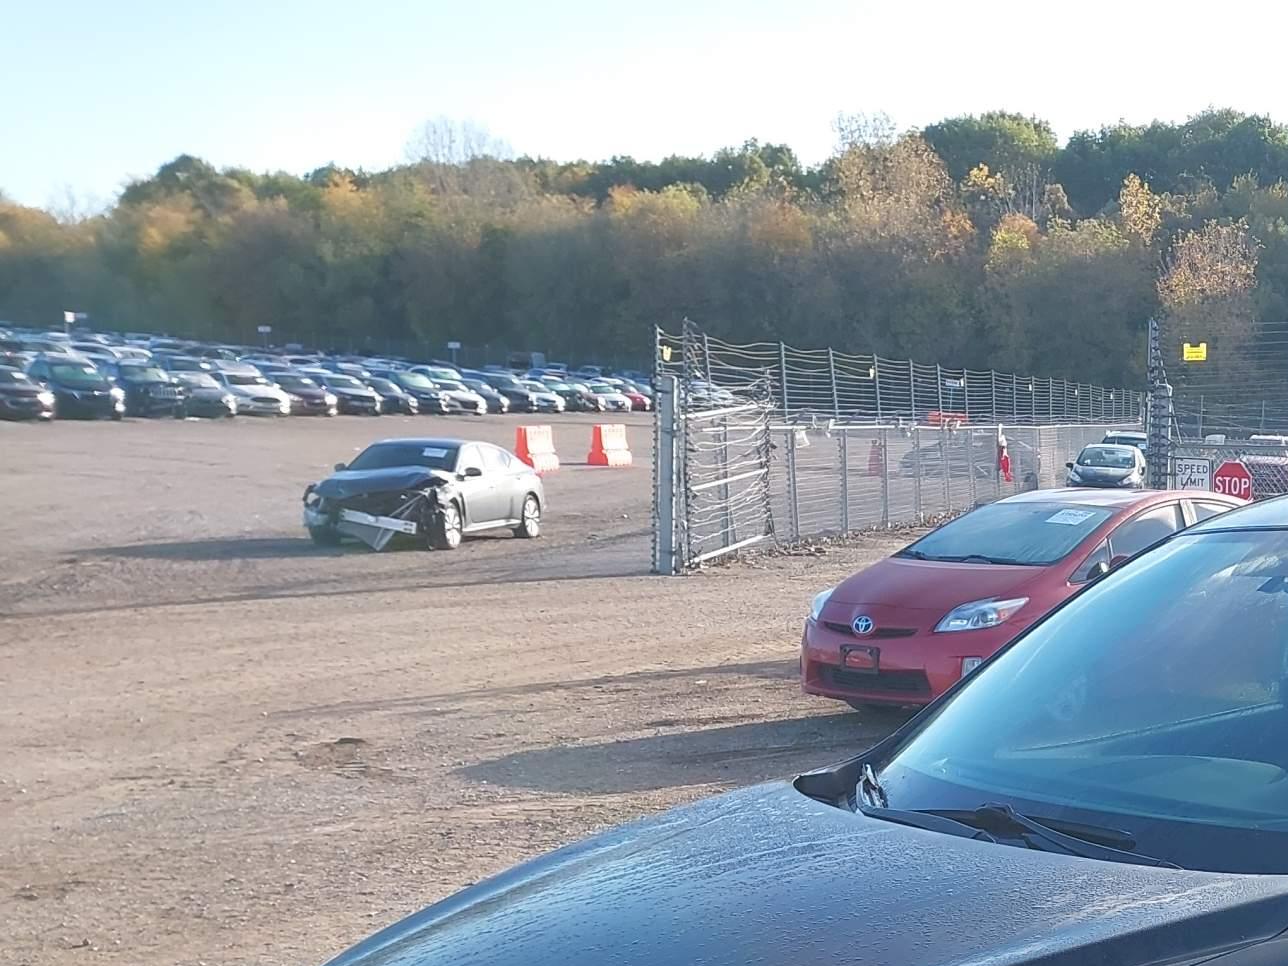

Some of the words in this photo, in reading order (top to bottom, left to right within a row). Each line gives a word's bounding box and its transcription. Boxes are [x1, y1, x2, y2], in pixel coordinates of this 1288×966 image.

[1177, 463, 1208, 474] SPEED
[1180, 477, 1205, 487] LIMIT
[1215, 476, 1250, 495] STOP
